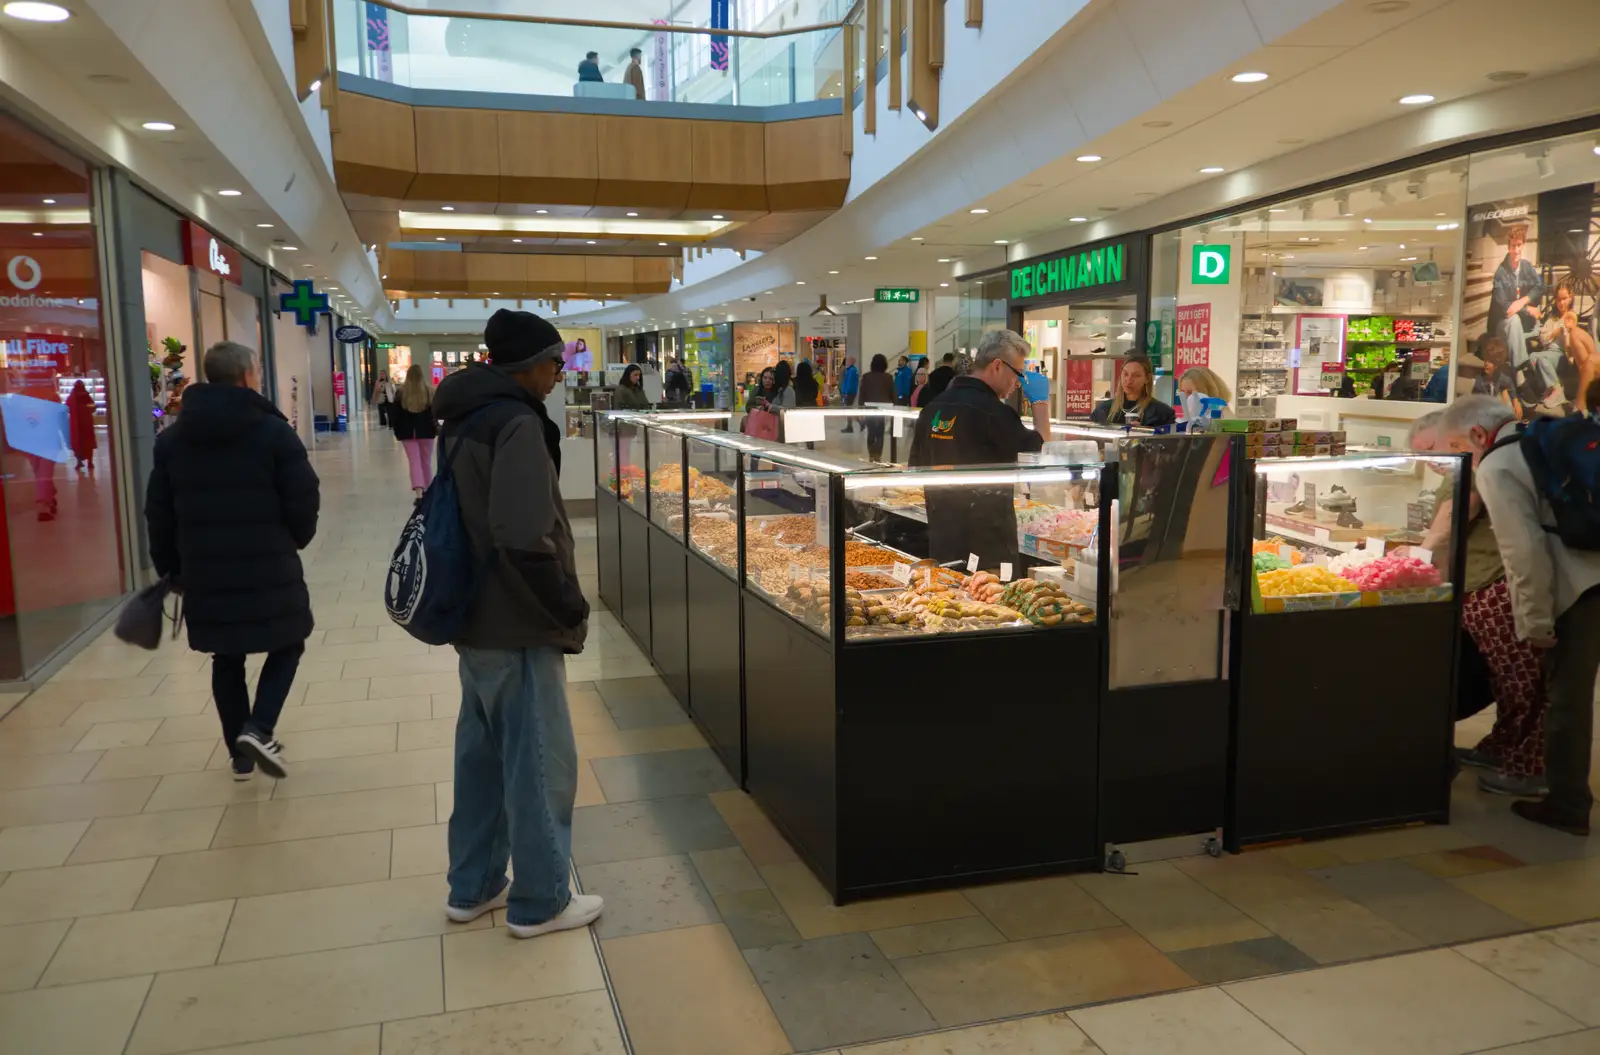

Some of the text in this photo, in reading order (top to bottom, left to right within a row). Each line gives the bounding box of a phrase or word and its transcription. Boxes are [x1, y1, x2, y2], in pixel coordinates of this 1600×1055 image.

[1011, 244, 1124, 299] DEICHMANN
[1198, 251, 1225, 278] D
[0, 294, 63, 308] odafone
[1177, 323, 1208, 344] HALF
[26, 339, 69, 354] Fibre
[813, 339, 840, 348] SALE
[1177, 347, 1207, 364] PRICE
[1067, 394, 1090, 402] HALF
